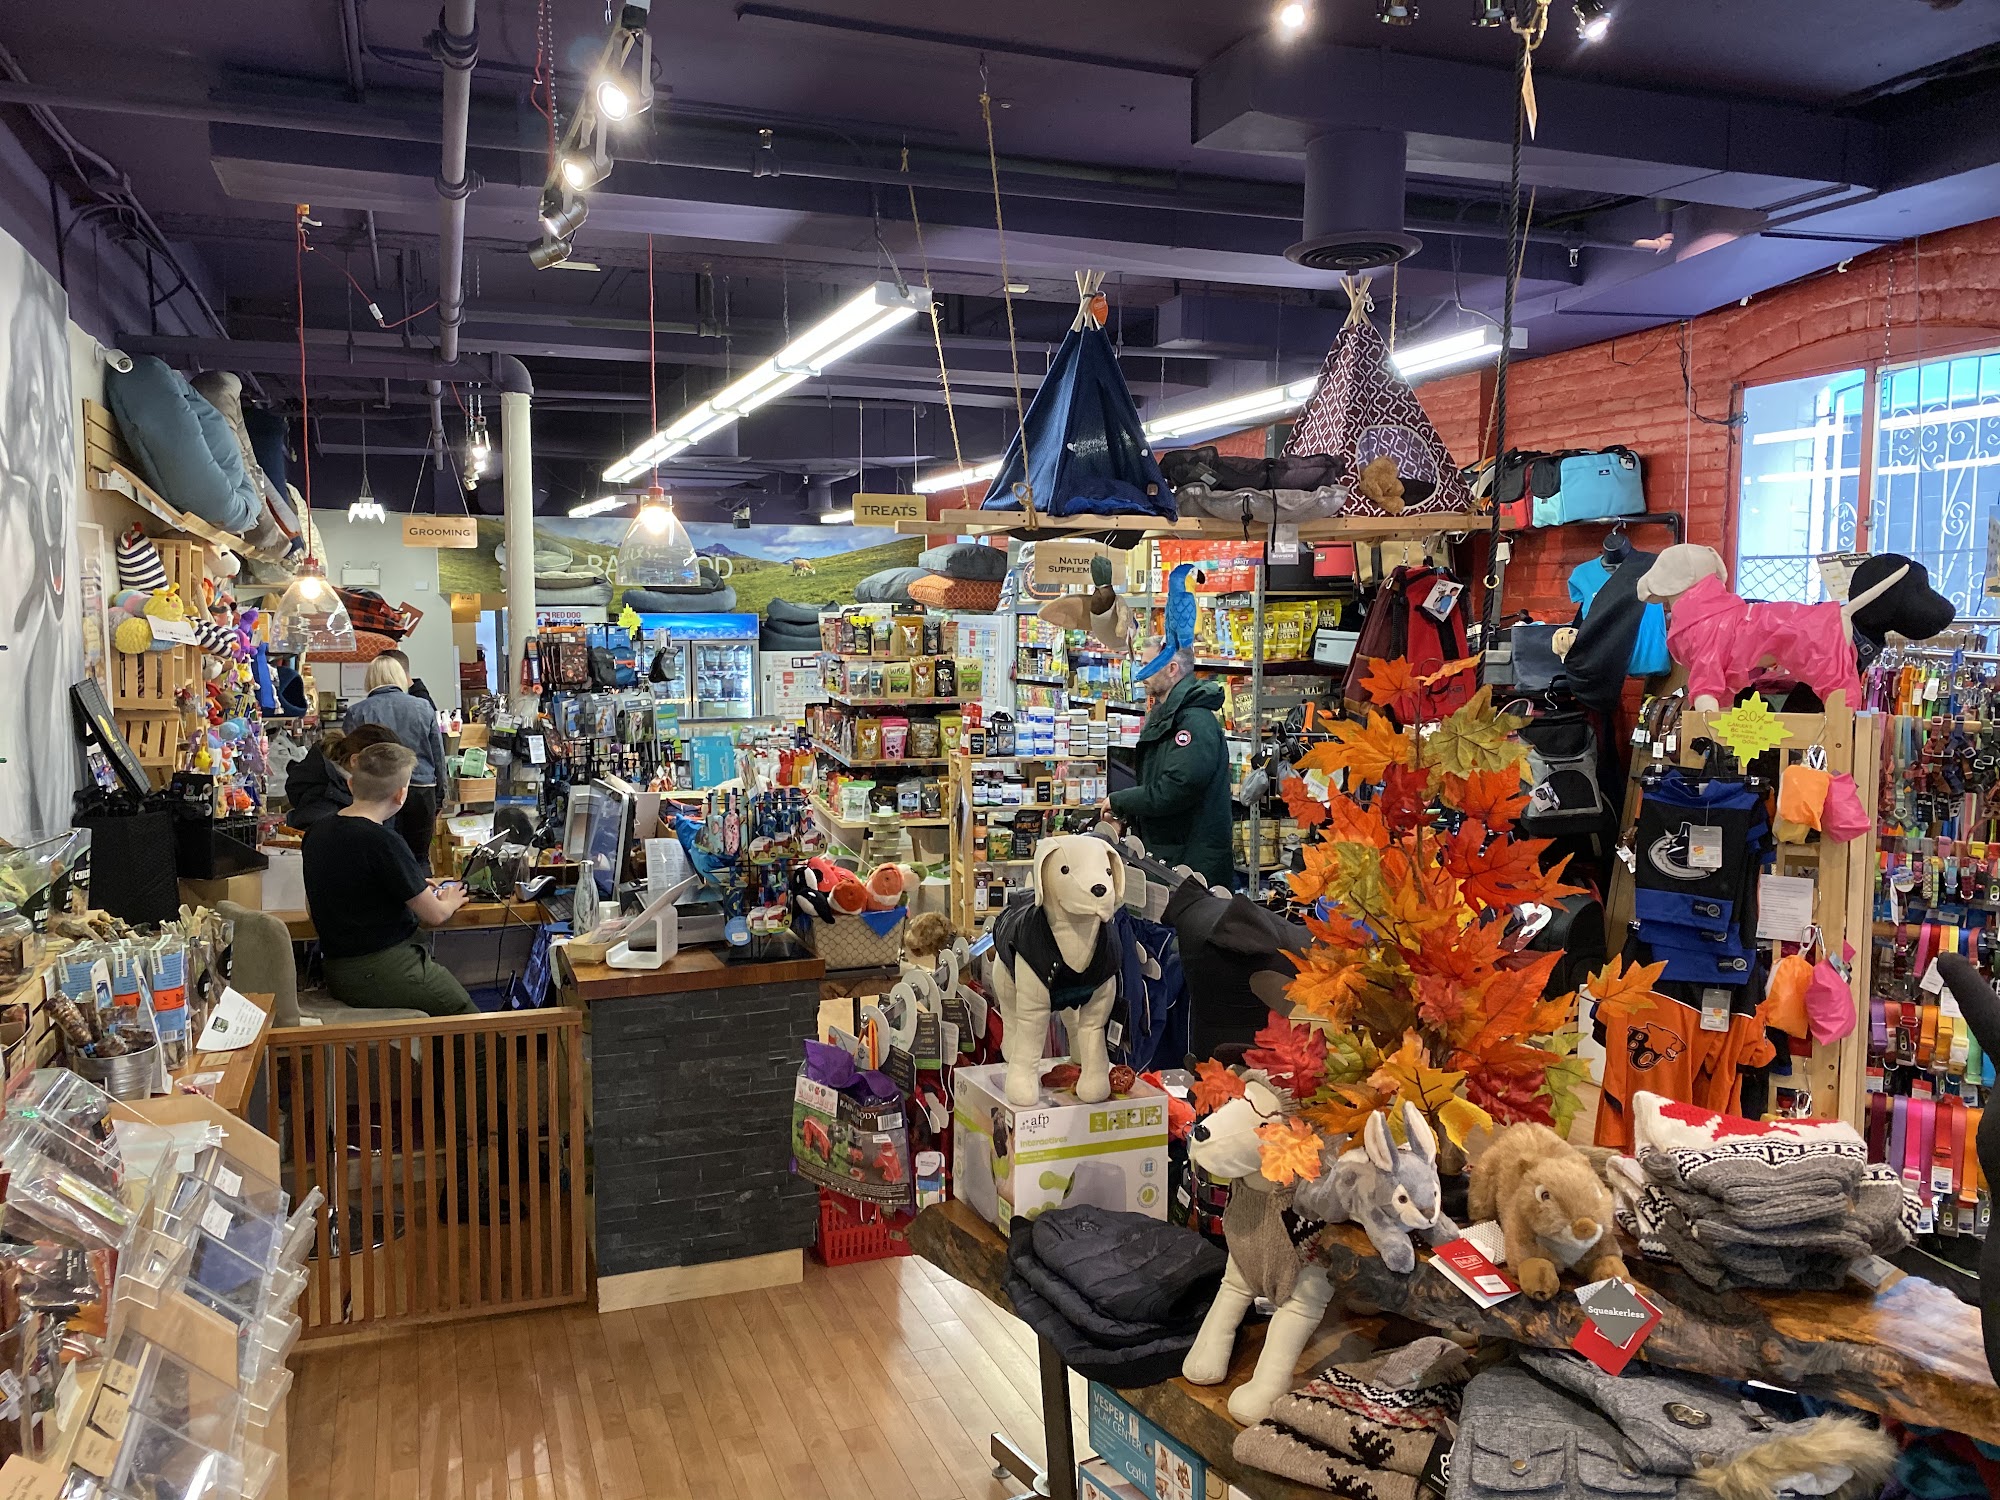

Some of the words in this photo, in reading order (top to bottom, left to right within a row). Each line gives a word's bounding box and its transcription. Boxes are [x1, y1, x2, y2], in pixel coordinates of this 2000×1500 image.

[861, 505, 917, 516] TREATS
[409, 527, 471, 537] GROOMING
[1059, 556, 1090, 565] NATUR
[1048, 565, 1090, 574] SUPPLEM
[1737, 709, 1766, 723] 20%
[839, 1099, 853, 1113] RAIN
[856, 1108, 878, 1121] BODY
[1030, 1113, 1050, 1128] afp
[1587, 1305, 1645, 1319] Squeakerless
[1093, 1389, 1125, 1426] VESPER
[1093, 1404, 1112, 1426] PLAY
[1112, 1419, 1142, 1452] CENTER
